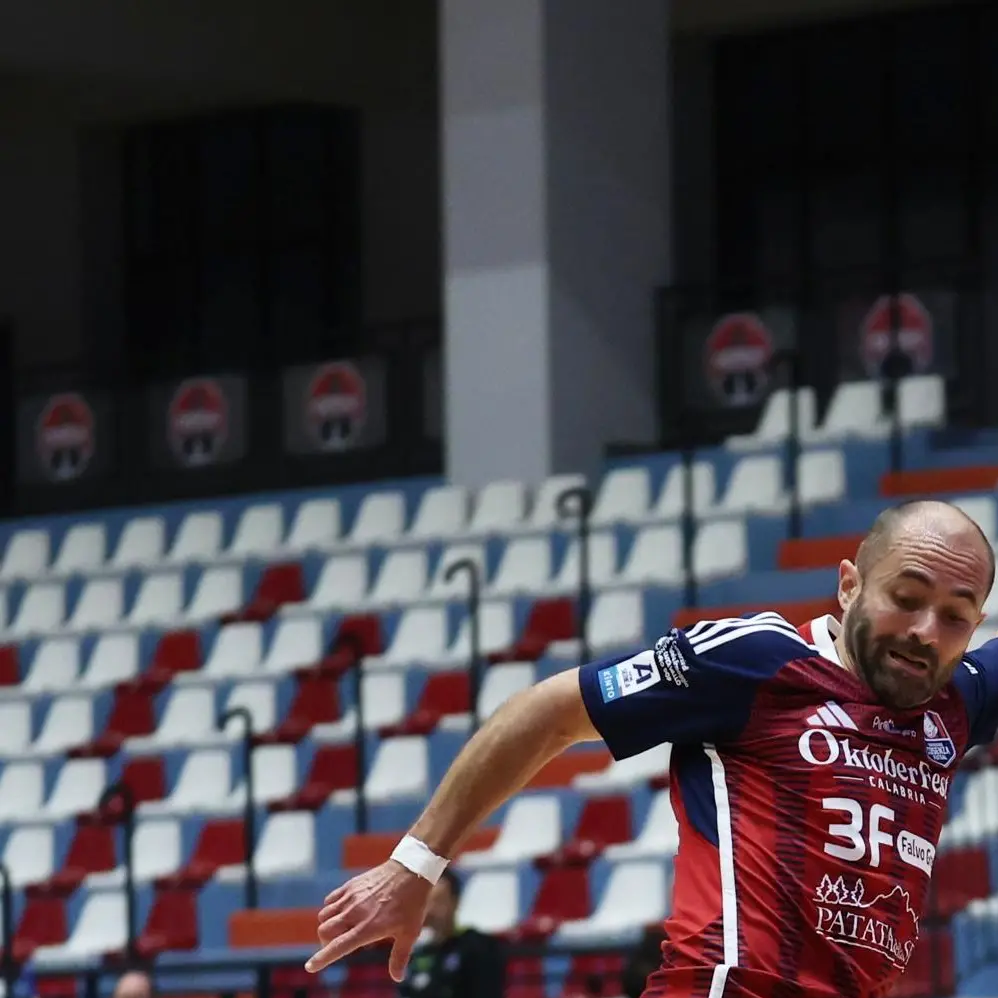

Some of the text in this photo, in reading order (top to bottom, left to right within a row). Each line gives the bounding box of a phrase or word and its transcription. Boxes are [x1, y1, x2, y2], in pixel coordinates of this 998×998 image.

[869, 776, 926, 805] CALABRIA
[822, 797, 895, 868] 3F
[901, 836, 925, 861] Falvo
[816, 907, 894, 953] PATATA
